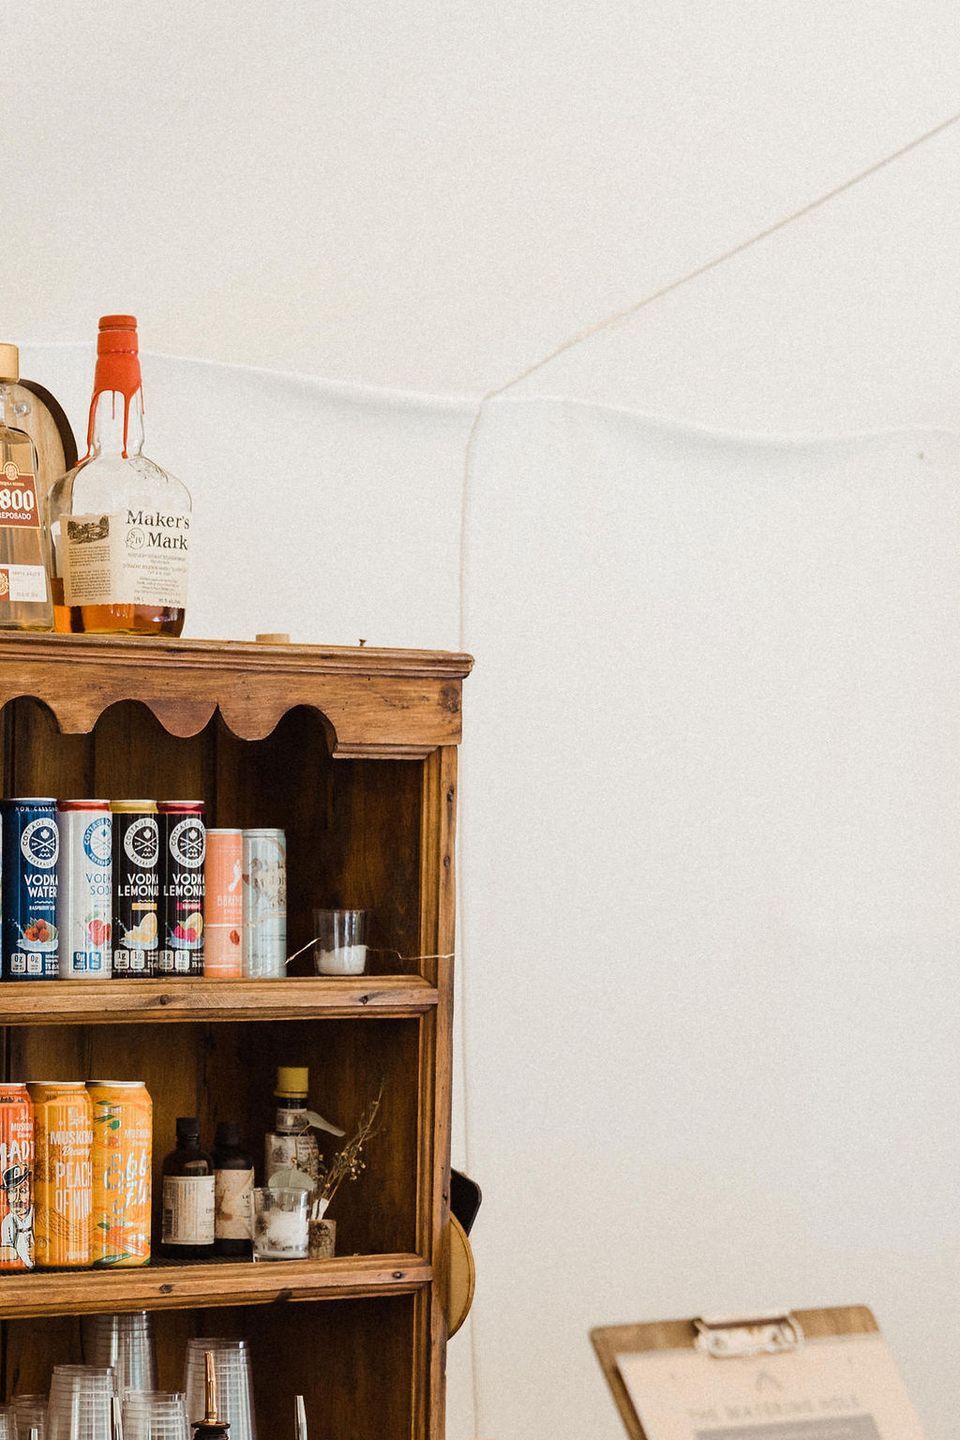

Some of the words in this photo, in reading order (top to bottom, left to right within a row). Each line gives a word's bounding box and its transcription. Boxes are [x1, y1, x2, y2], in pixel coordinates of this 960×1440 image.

[126, 510, 190, 529] Maker's
[147, 532, 188, 550] Mark
[28, 887, 57, 898] WATER
[55, 1162, 93, 1188] PEACH
